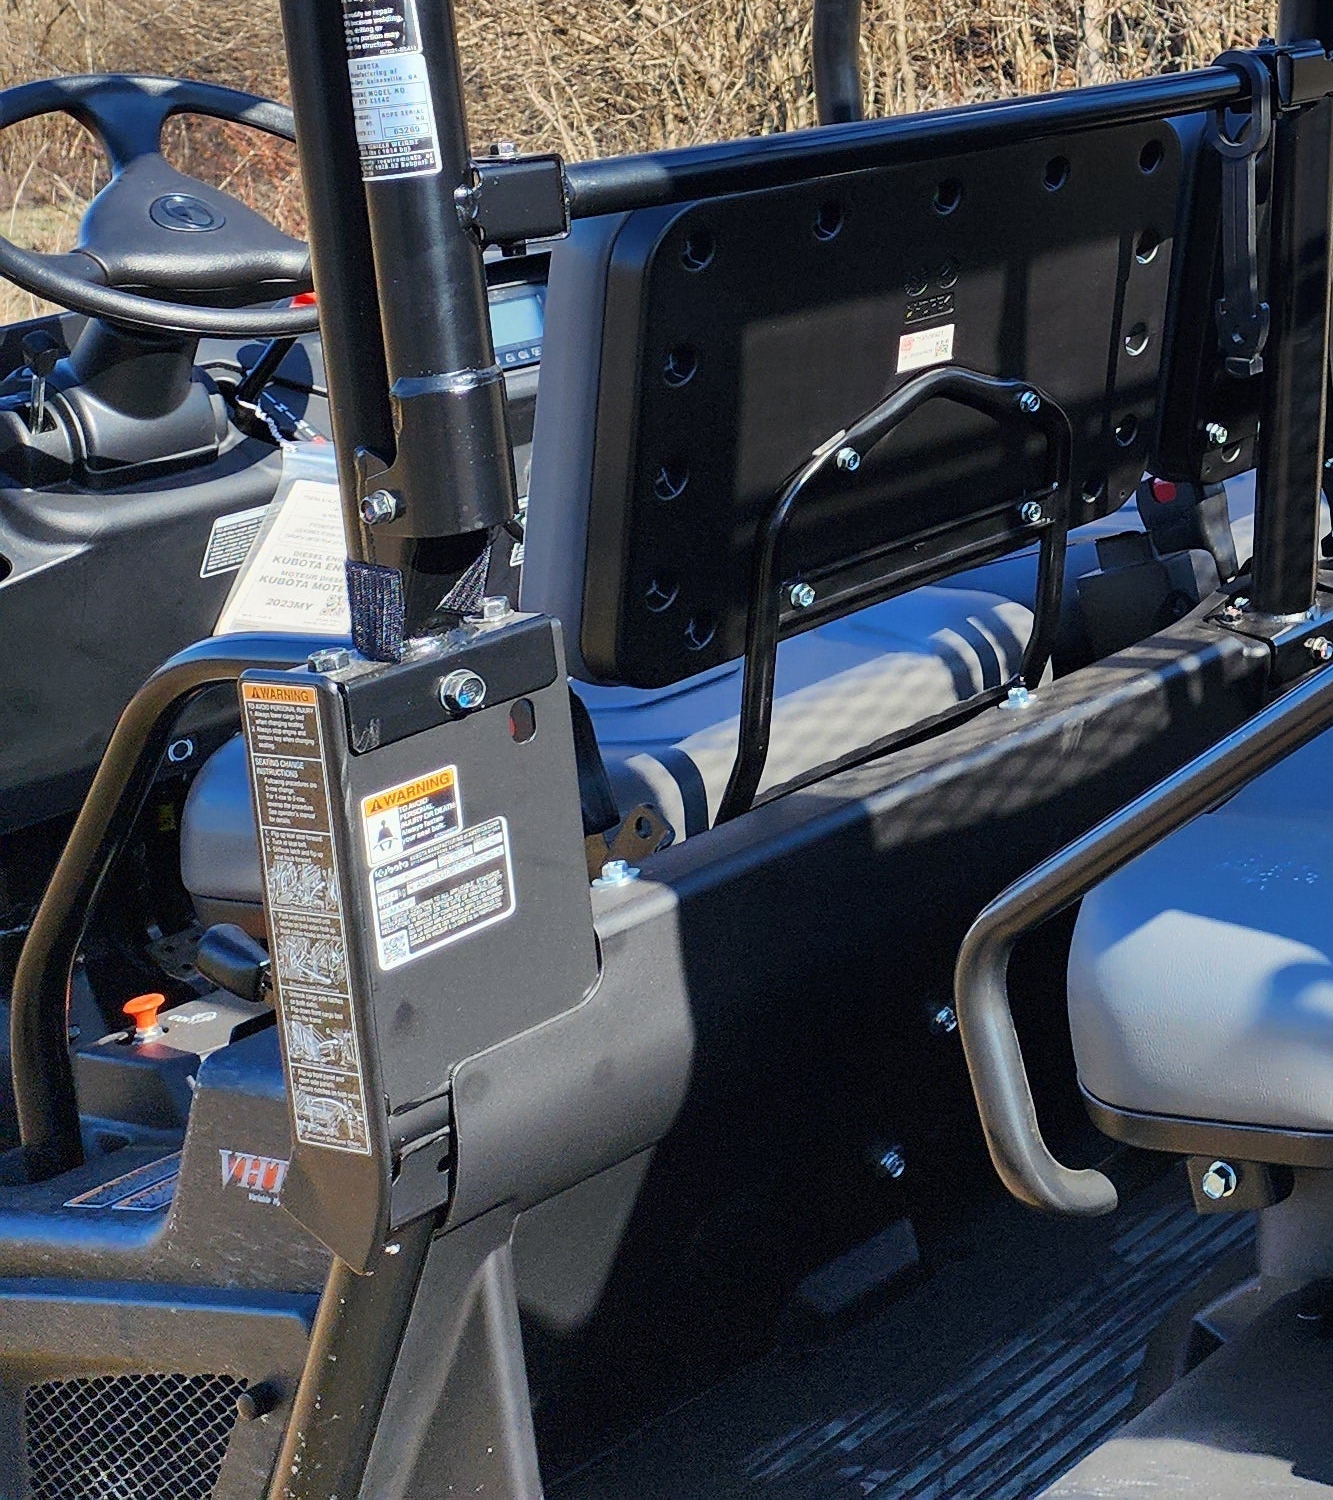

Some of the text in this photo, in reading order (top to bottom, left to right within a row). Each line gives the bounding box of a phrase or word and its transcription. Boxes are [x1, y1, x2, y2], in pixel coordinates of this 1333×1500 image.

[272, 556, 322, 569] KUBOTA
[259, 575, 344, 592] KUBOTA MOTE
[265, 598, 314, 610] 2023MY
[260, 688, 308, 701] WARNING
[280, 760, 304, 769] CHANGE
[384, 773, 449, 806] WARNING
[408, 797, 429, 809] AVOID
[400, 803, 435, 820] PERSONAL
[401, 815, 422, 828] INJURY
[424, 812, 434, 820] OR
[401, 823, 423, 836] Always
[402, 834, 416, 845] your
[374, 861, 409, 877] Kubota
